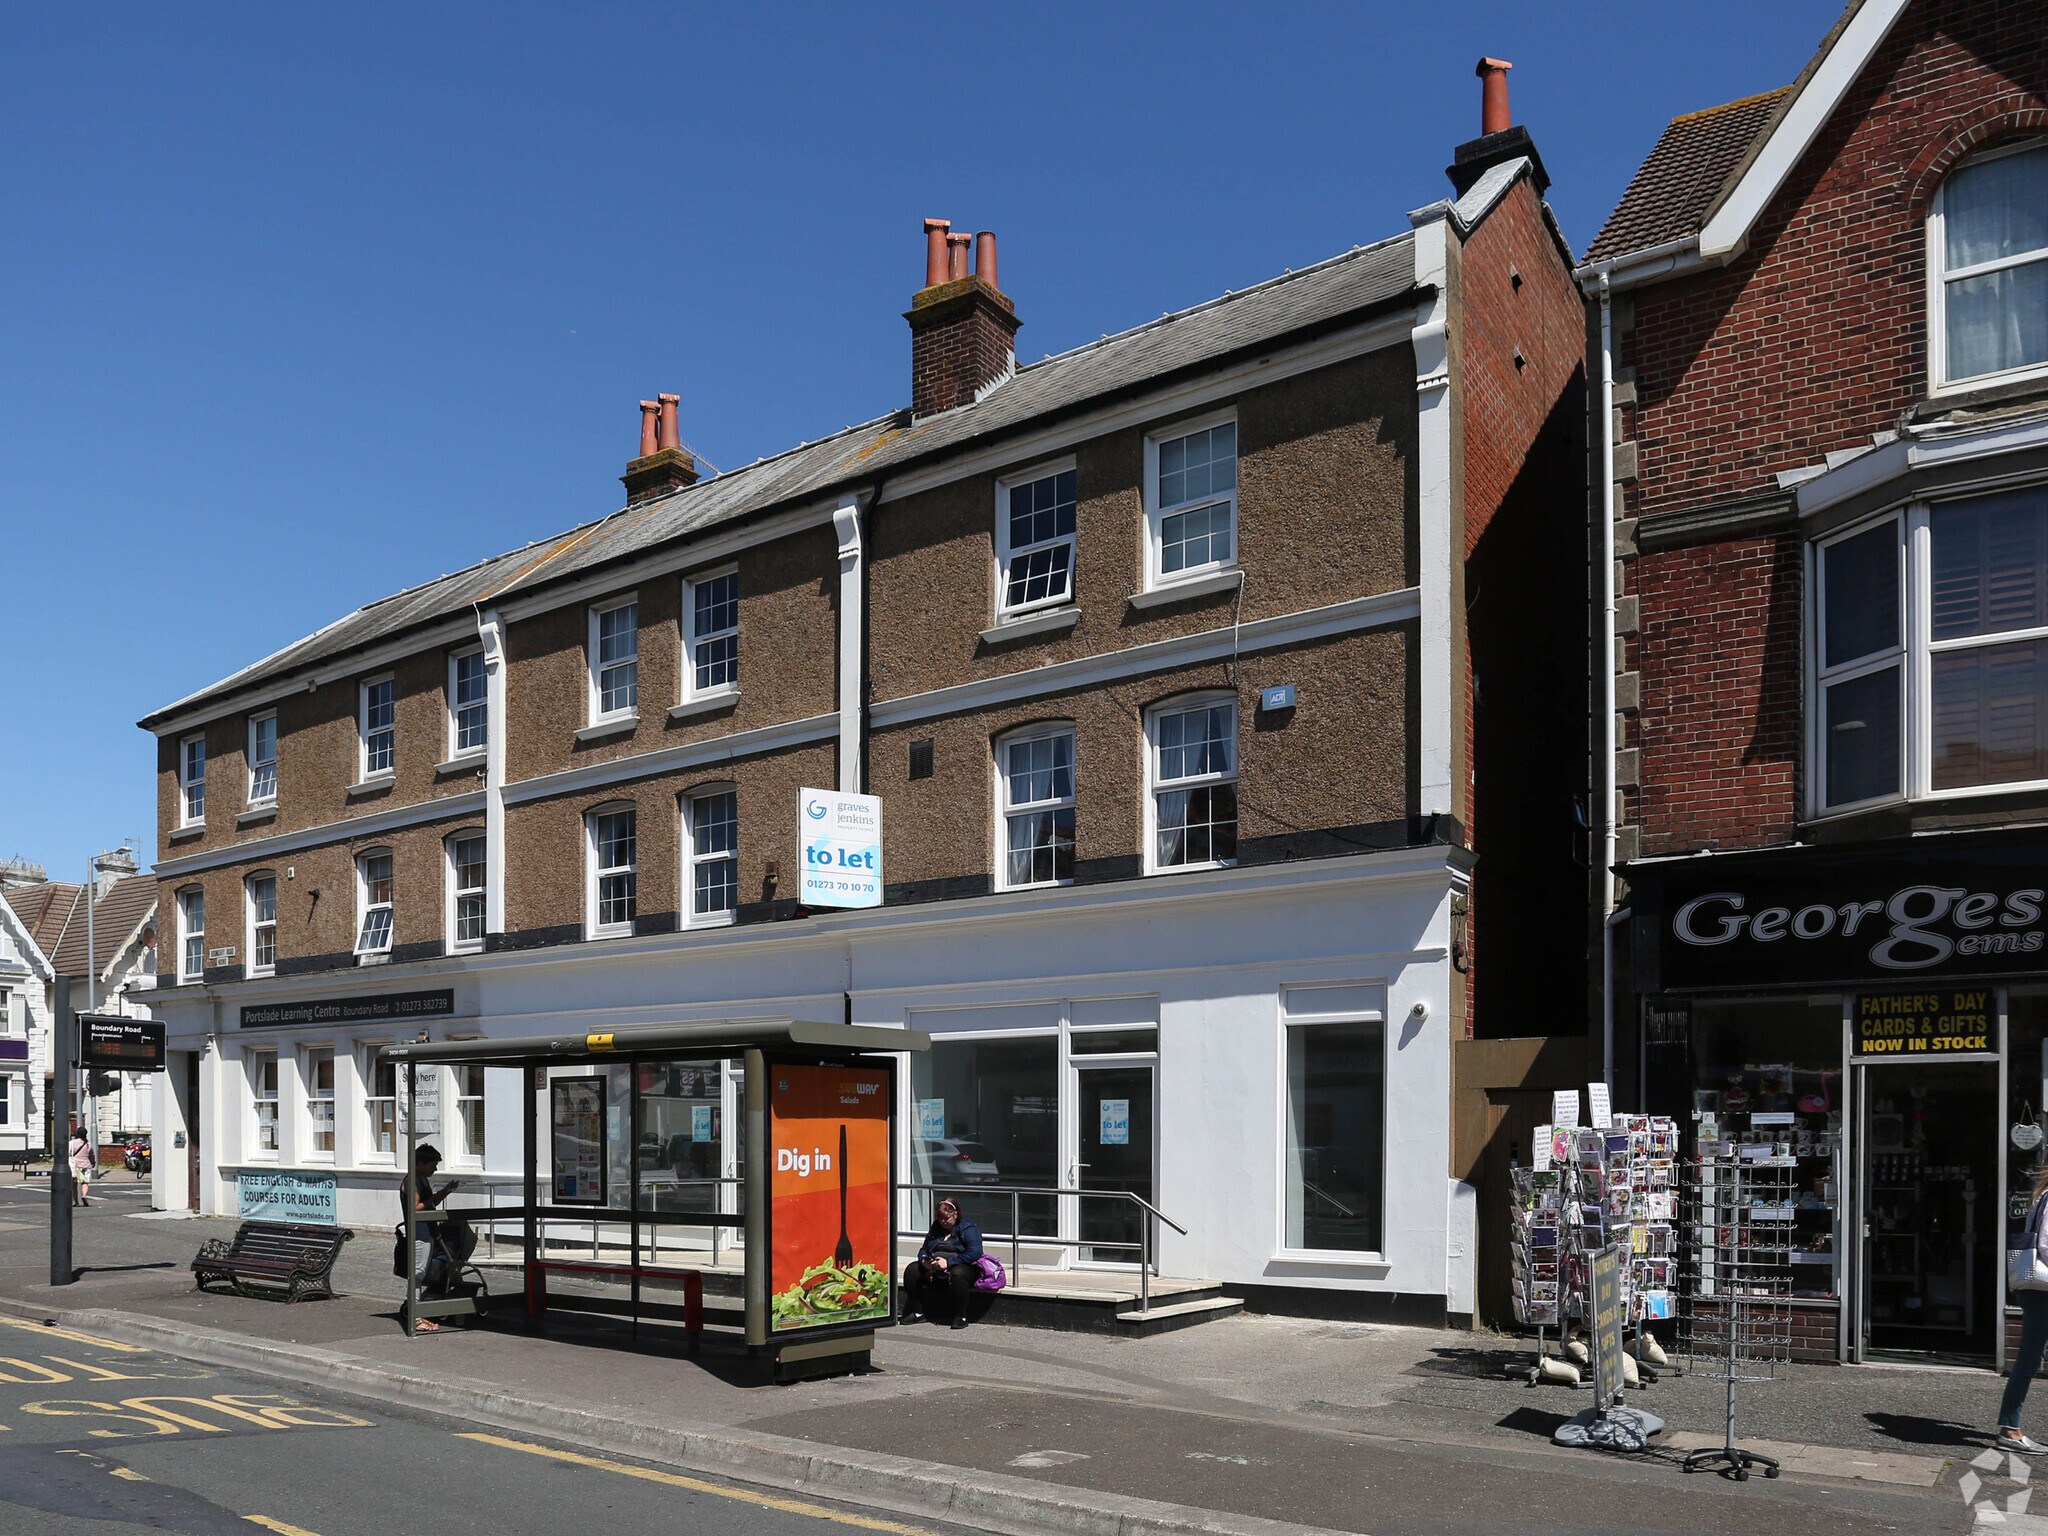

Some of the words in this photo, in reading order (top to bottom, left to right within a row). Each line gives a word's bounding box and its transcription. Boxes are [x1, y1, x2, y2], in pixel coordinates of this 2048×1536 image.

[837, 803, 870, 813] graves
[837, 812, 874, 825] jenkins
[806, 846, 833, 865] to
[838, 848, 873, 869] let
[807, 879, 834, 889] 01273
[837, 882, 848, 891] 70
[851, 883, 860, 891] 10
[863, 884, 874, 892] 70
[1673, 885, 2045, 970] Georges
[245, 1008, 280, 1023] Portslade
[281, 1006, 313, 1021] Learning
[314, 1005, 341, 1018] Centre
[343, 1005, 373, 1016] Boundary
[373, 1002, 389, 1014] Road
[401, 1000, 422, 1012] 01273
[423, 998, 448, 1010] 382739
[1861, 994, 1939, 1015] FATHER'S
[1954, 992, 1987, 1011] DAY
[91, 1024, 124, 1033] Boundary
[1861, 1017, 1916, 1036] CARDS
[1921, 1017, 1932, 1034] &
[1938, 1014, 1987, 1034] GIFTS
[1862, 1038, 1903, 1052] NOW
[1908, 1038, 1927, 1050] IN
[1932, 1036, 1987, 1050] STOCK
[839, 1082, 880, 1095] SUBWAY
[839, 1096, 859, 1104] Salads
[1103, 1120, 1112, 1129] to
[1114, 1120, 1127, 1129] let
[777, 1148, 810, 1177] Dig
[814, 1147, 831, 1171] in
[240, 1174, 259, 1186] FREE
[261, 1174, 294, 1188] ENGLISH
[296, 1177, 303, 1188] &
[304, 1177, 334, 1190] MATHS
[244, 1191, 279, 1203] COURSES
[281, 1193, 297, 1205] FOR
[298, 1194, 331, 1207] ADULTS
[285, 1211, 335, 1222] www.portslade.org
[1601, 1281, 1612, 1302] DAY
